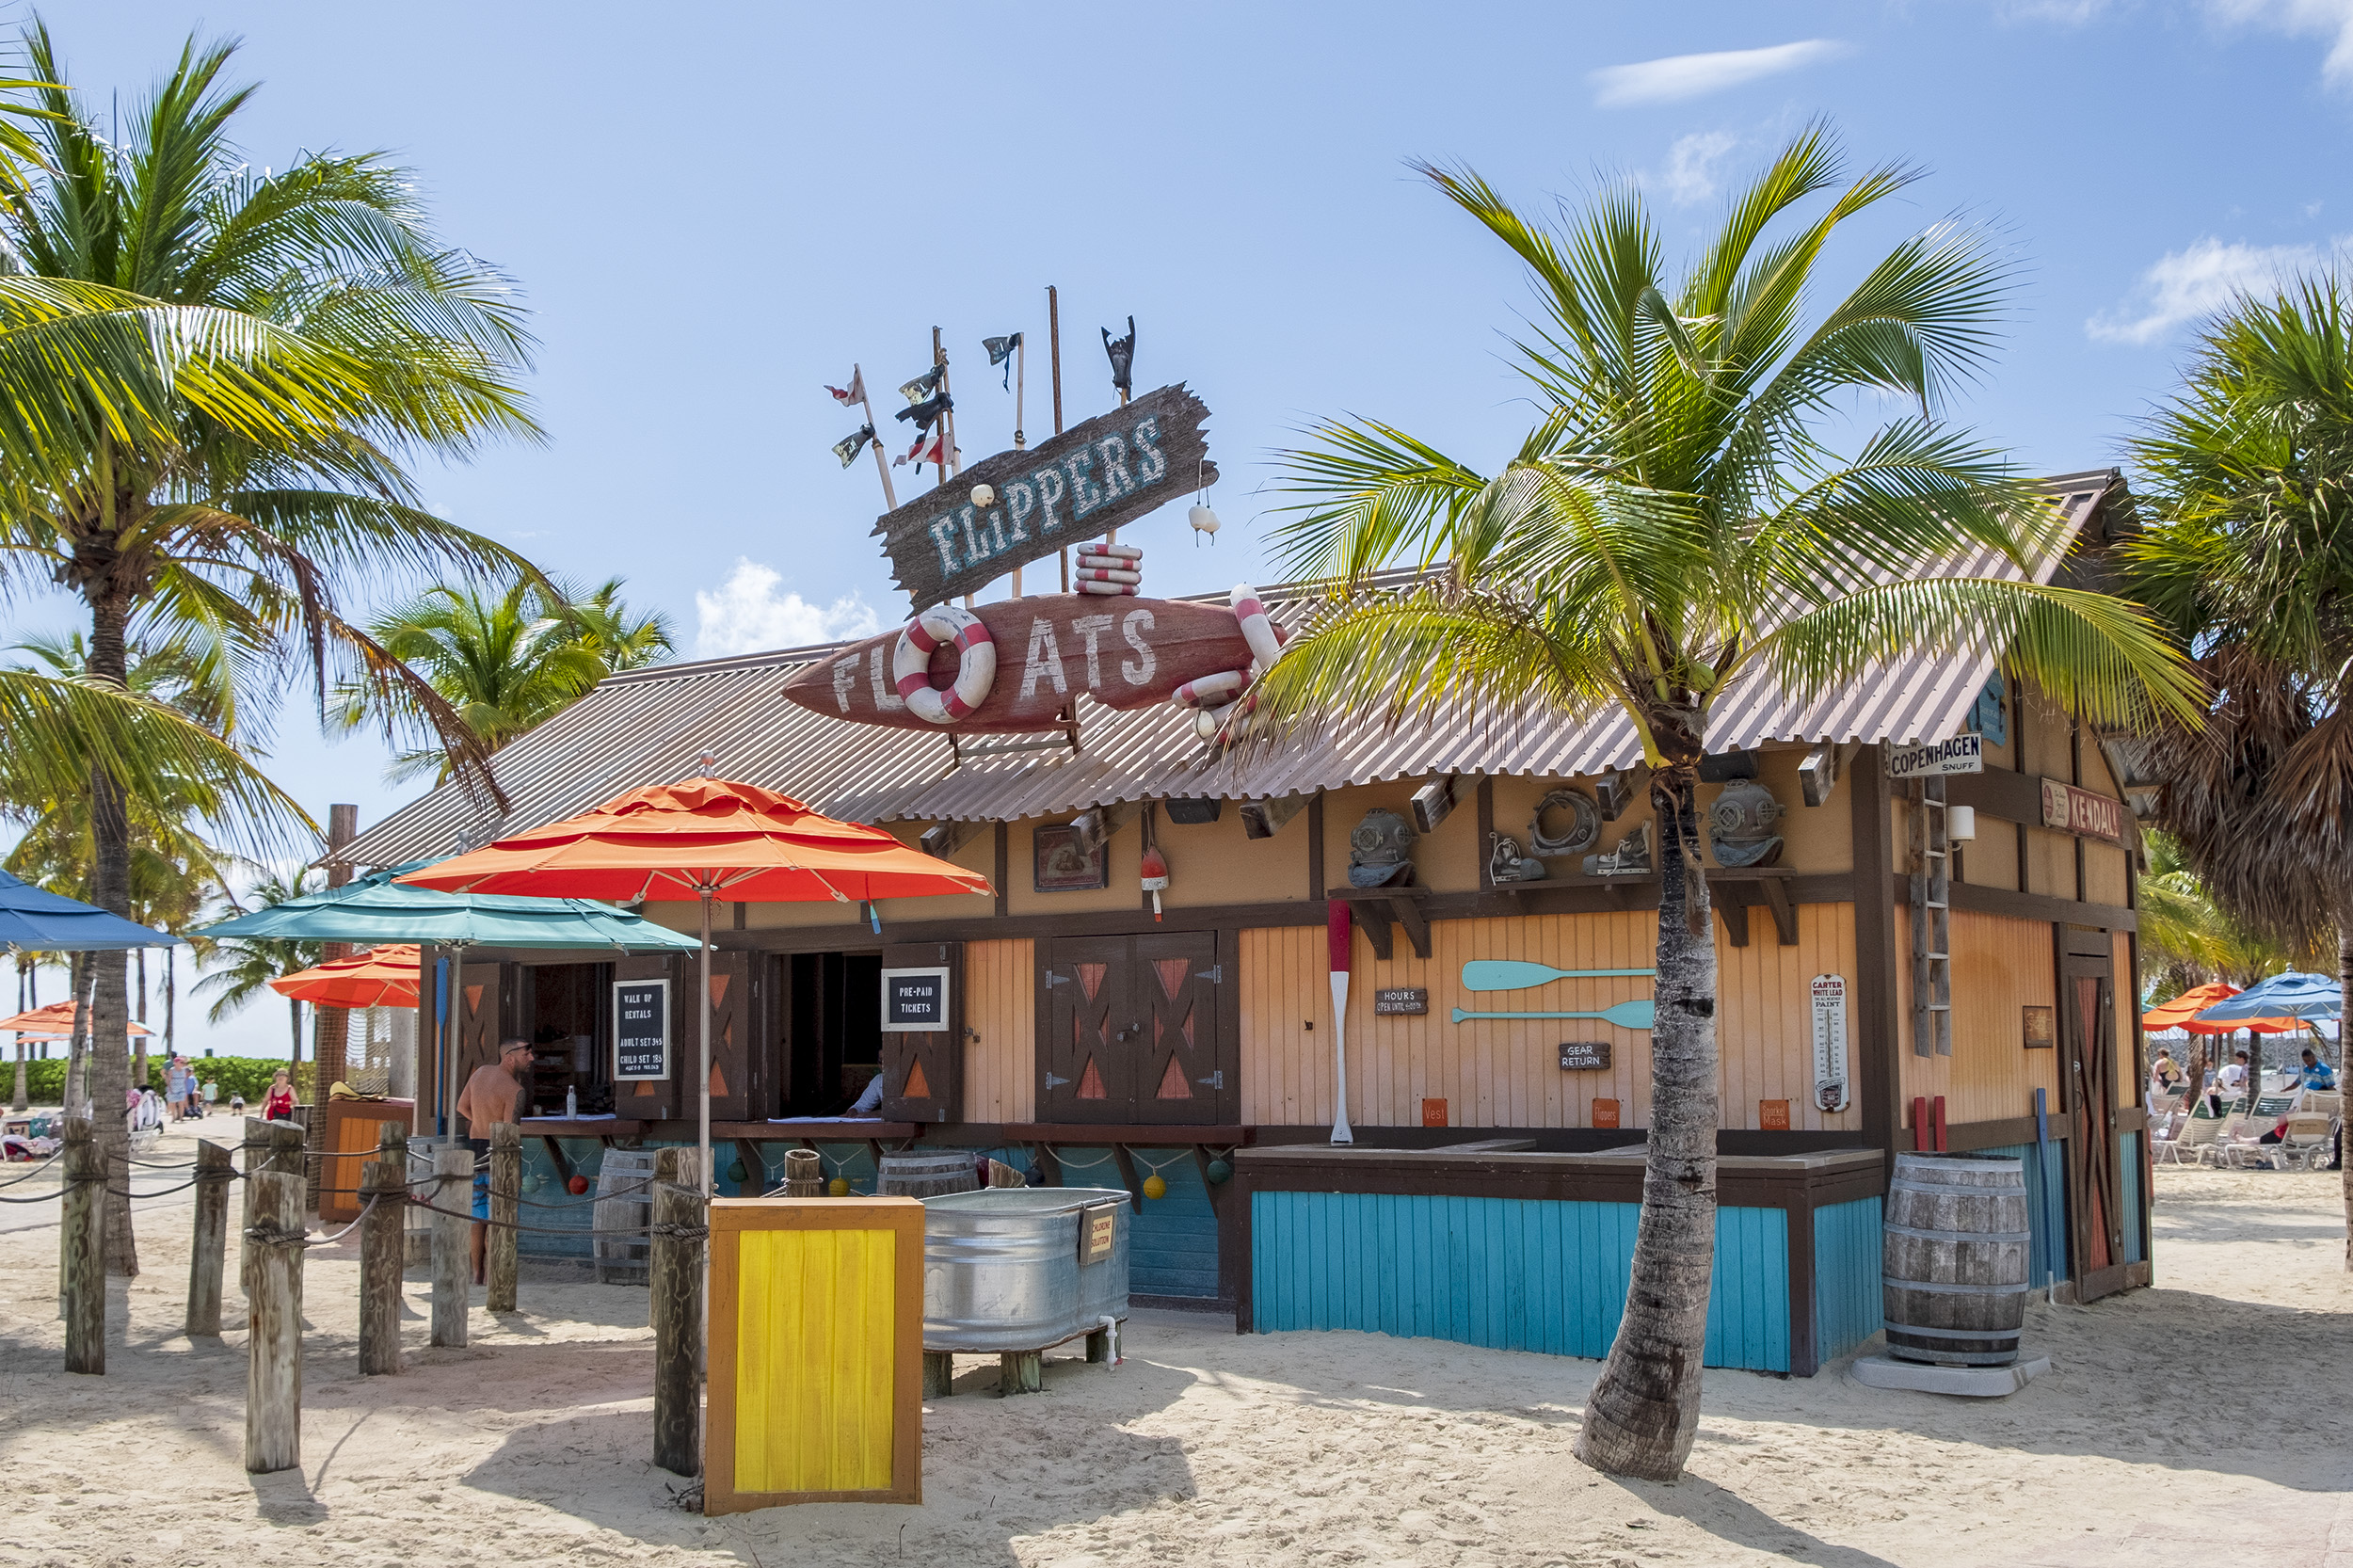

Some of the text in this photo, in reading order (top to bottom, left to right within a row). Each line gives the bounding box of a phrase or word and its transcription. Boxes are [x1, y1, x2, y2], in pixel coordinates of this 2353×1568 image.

[1891, 736, 1979, 776] COPENHAGEN
[1942, 761, 1975, 772] SNUFF
[1812, 981, 1842, 989] CARTER
[899, 986, 933, 997] PRE-PAID
[1385, 991, 1415, 1000] HOURS
[624, 994, 640, 1004] WALK
[901, 1003, 931, 1014] TICKETS
[1377, 1002, 1391, 1012] OPEN
[1392, 1002, 1405, 1012] UNTIL
[625, 1010, 651, 1019] RENTALS
[620, 1037, 639, 1048] ADULT
[640, 1037, 651, 1048] SET
[1567, 1045, 1593, 1056] GEAR
[620, 1055, 637, 1064] CHILD
[639, 1054, 649, 1064] SET
[1561, 1056, 1600, 1066] RETURN
[1424, 1106, 1445, 1120] Vest
[1594, 1106, 1617, 1121] Flippers
[1763, 1115, 1786, 1126] Mask
